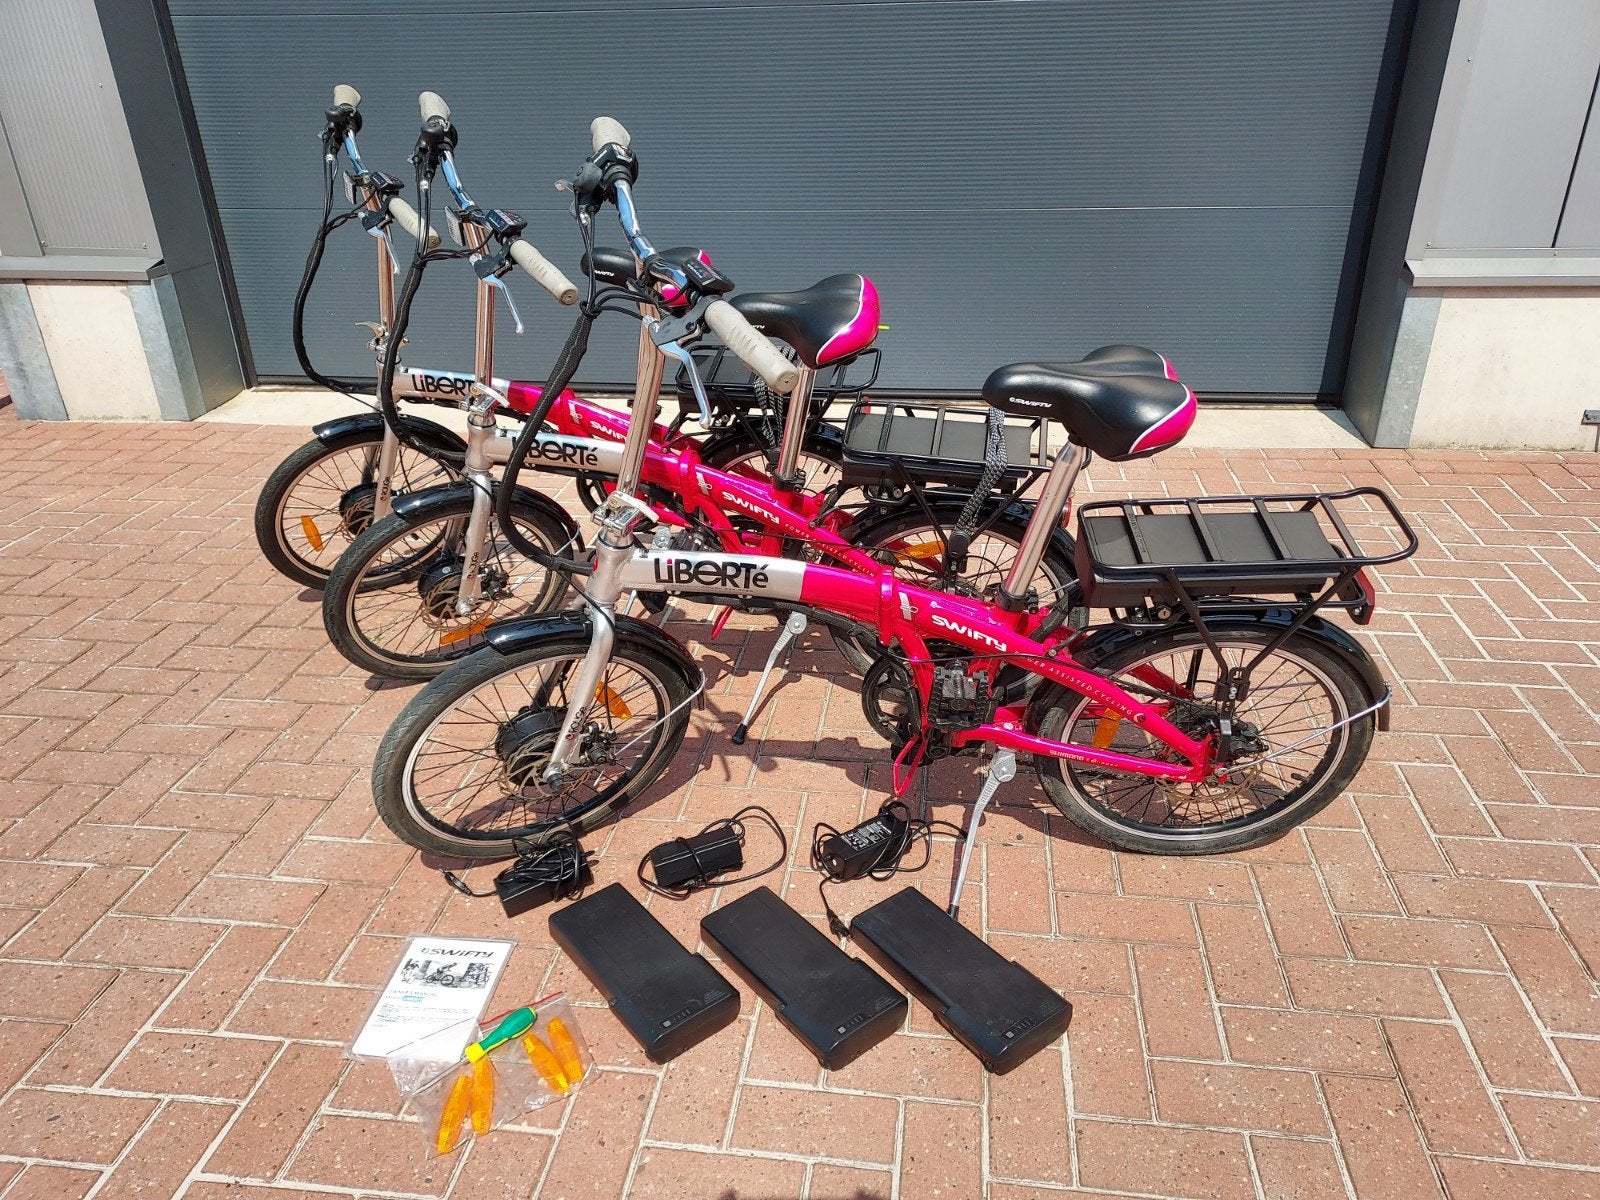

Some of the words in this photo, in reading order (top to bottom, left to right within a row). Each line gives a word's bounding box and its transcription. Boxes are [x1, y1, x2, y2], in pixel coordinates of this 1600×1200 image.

[411, 374, 475, 397] LiBeRT
[511, 436, 598, 466] BeRTé
[848, 558, 876, 578] CYCLIN
[1014, 650, 1047, 669] WER
[1049, 667, 1093, 692] ASSISTED
[1094, 690, 1134, 716] CYCLING
